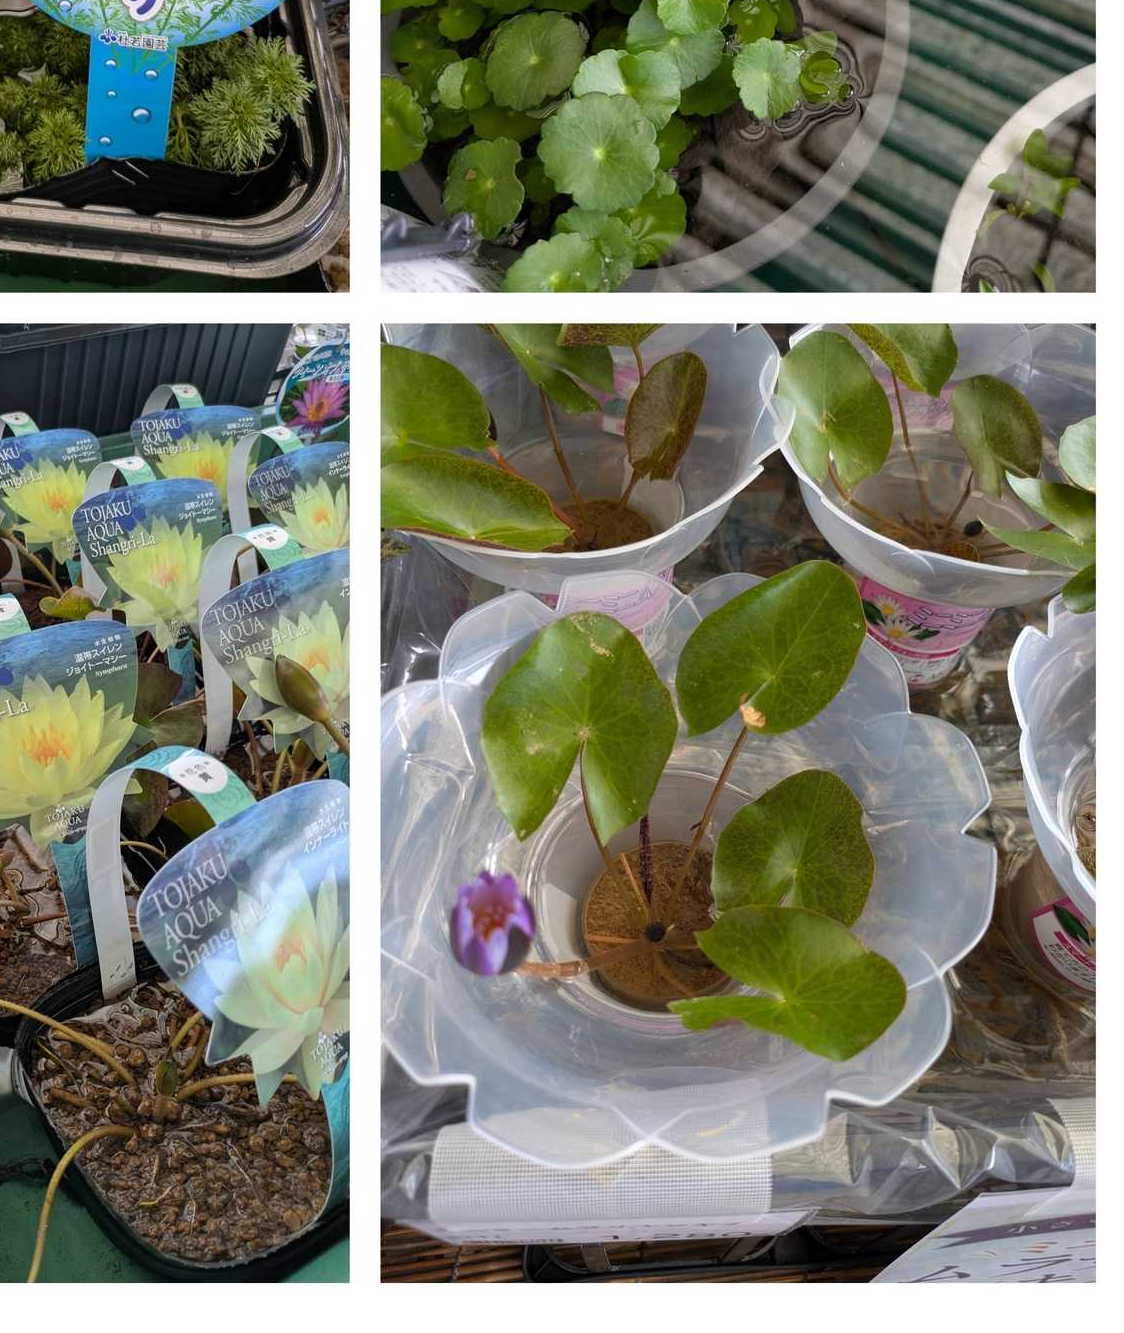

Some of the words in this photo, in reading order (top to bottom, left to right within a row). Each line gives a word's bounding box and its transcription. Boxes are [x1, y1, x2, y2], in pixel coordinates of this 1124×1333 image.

[117, 35, 169, 51] 杜若園芸
[140, 417, 181, 431] TOJAKU
[141, 432, 173, 444] AQUA
[82, 500, 133, 525] TOJAKU
[86, 521, 125, 542] AQUA
[209, 589, 277, 625] TOJAKU
[219, 616, 266, 648] AQUA
[147, 852, 229, 919] TOJAKU
[164, 896, 224, 951] AQUA
